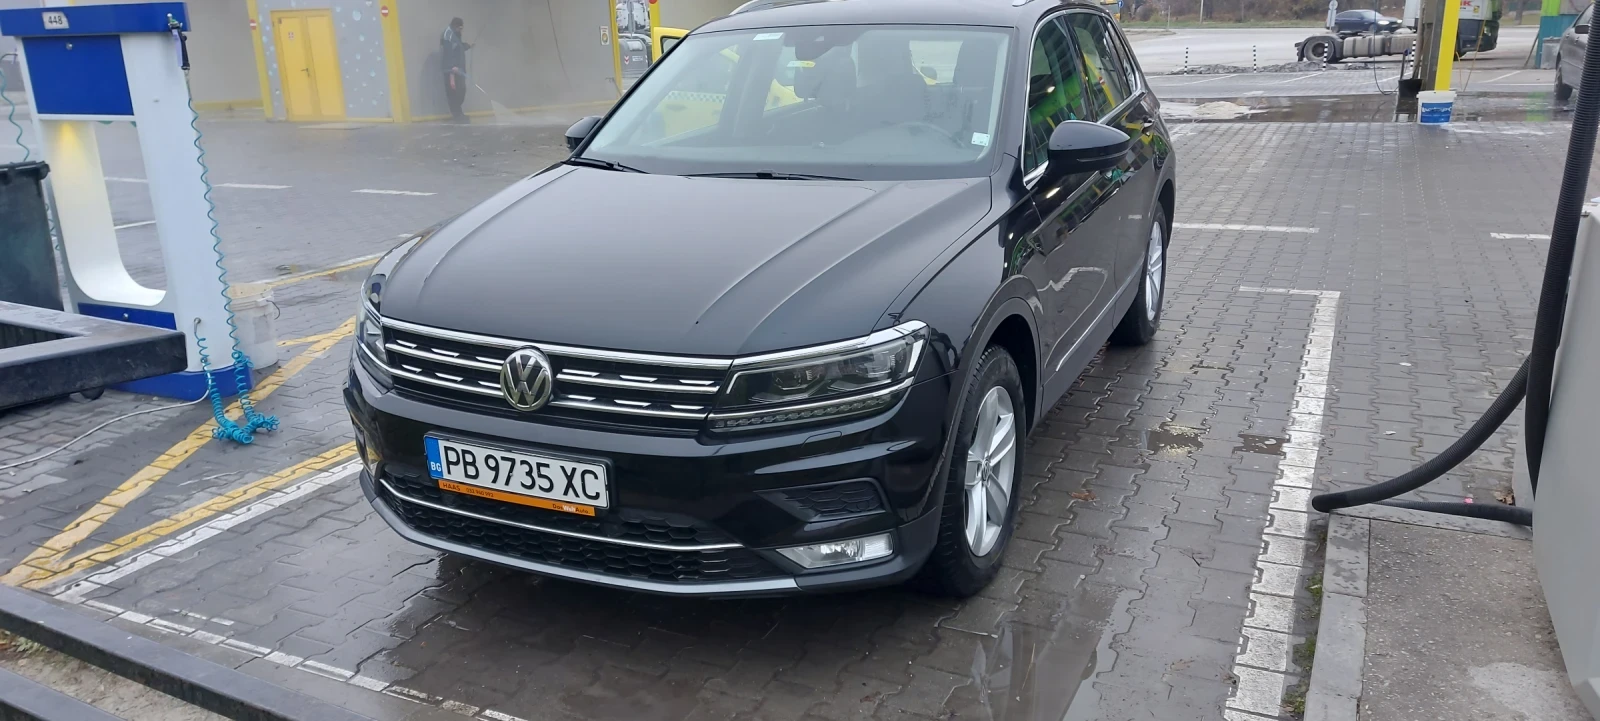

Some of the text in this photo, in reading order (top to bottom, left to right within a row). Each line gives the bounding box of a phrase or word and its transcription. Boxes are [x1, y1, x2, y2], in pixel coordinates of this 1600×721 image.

[48, 16, 63, 25] 448
[430, 462, 442, 472] BG
[443, 445, 600, 500] PB 9735 XC
[443, 482, 461, 492] HAAS
